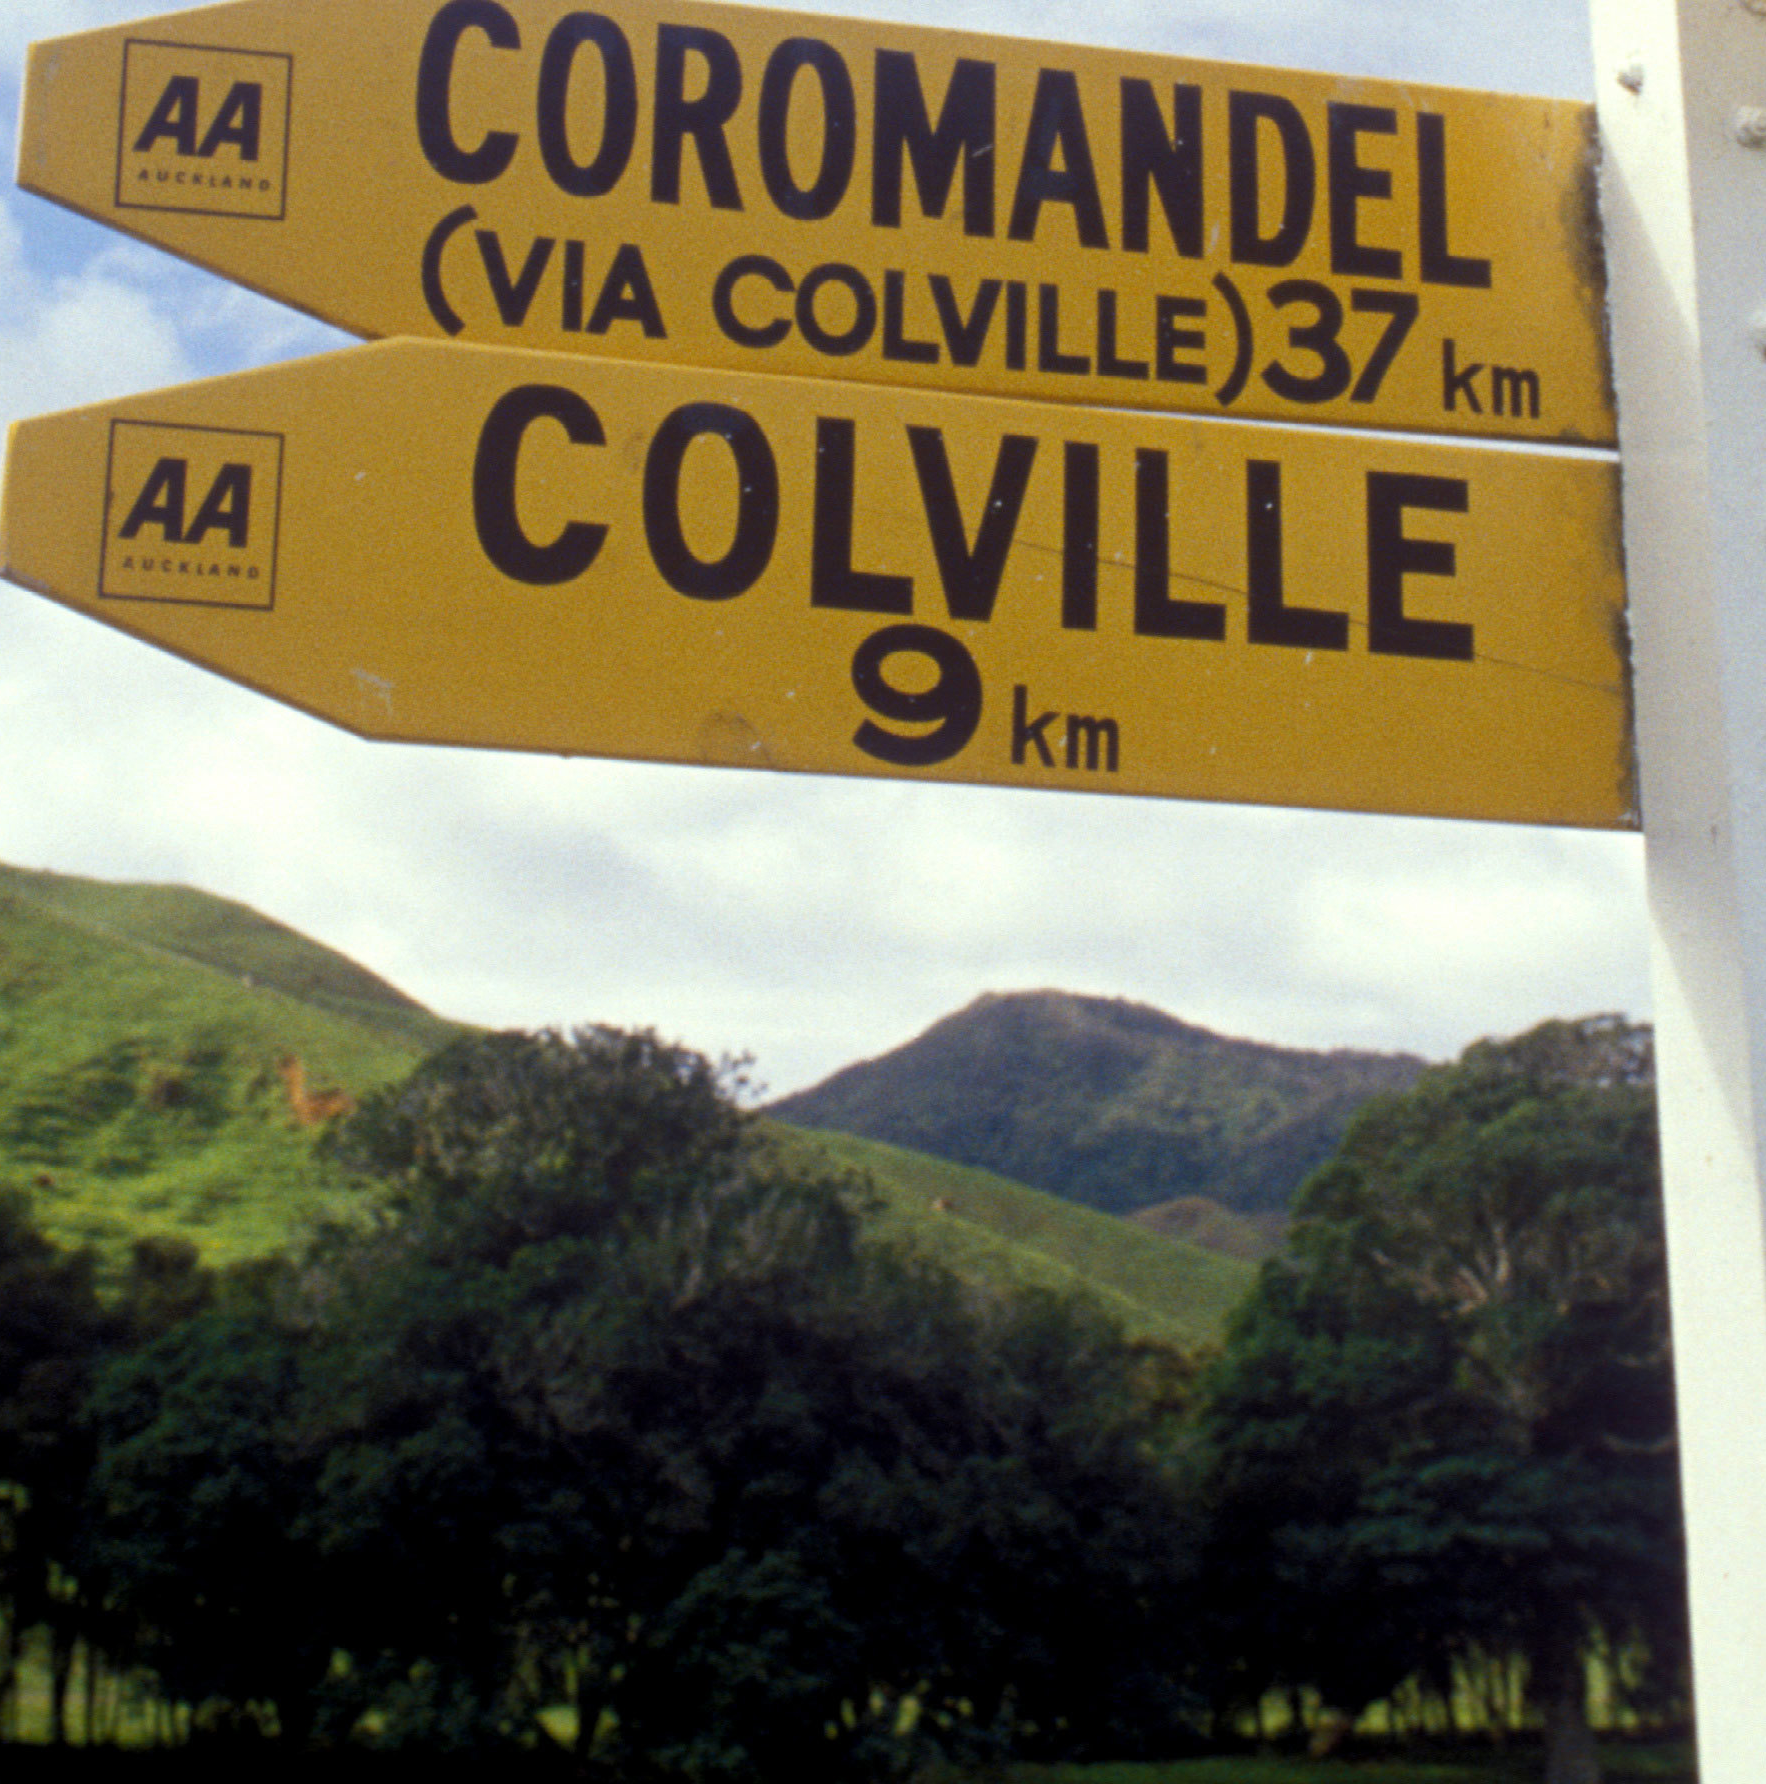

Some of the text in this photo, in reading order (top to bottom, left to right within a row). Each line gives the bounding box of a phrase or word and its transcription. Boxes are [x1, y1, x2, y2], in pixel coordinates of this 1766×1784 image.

[132, 75, 262, 162] AA
[136, 169, 271, 192] AUCKLAND
[421, 204, 667, 340] (VIA
[1261, 280, 1420, 404] 37
[1443, 339, 1541, 419] km
[118, 458, 252, 549] AA
[472, 384, 1474, 661] COLVILLE
[122, 556, 259, 580] AUCKLAND
[851, 623, 1120, 773] 9 km
